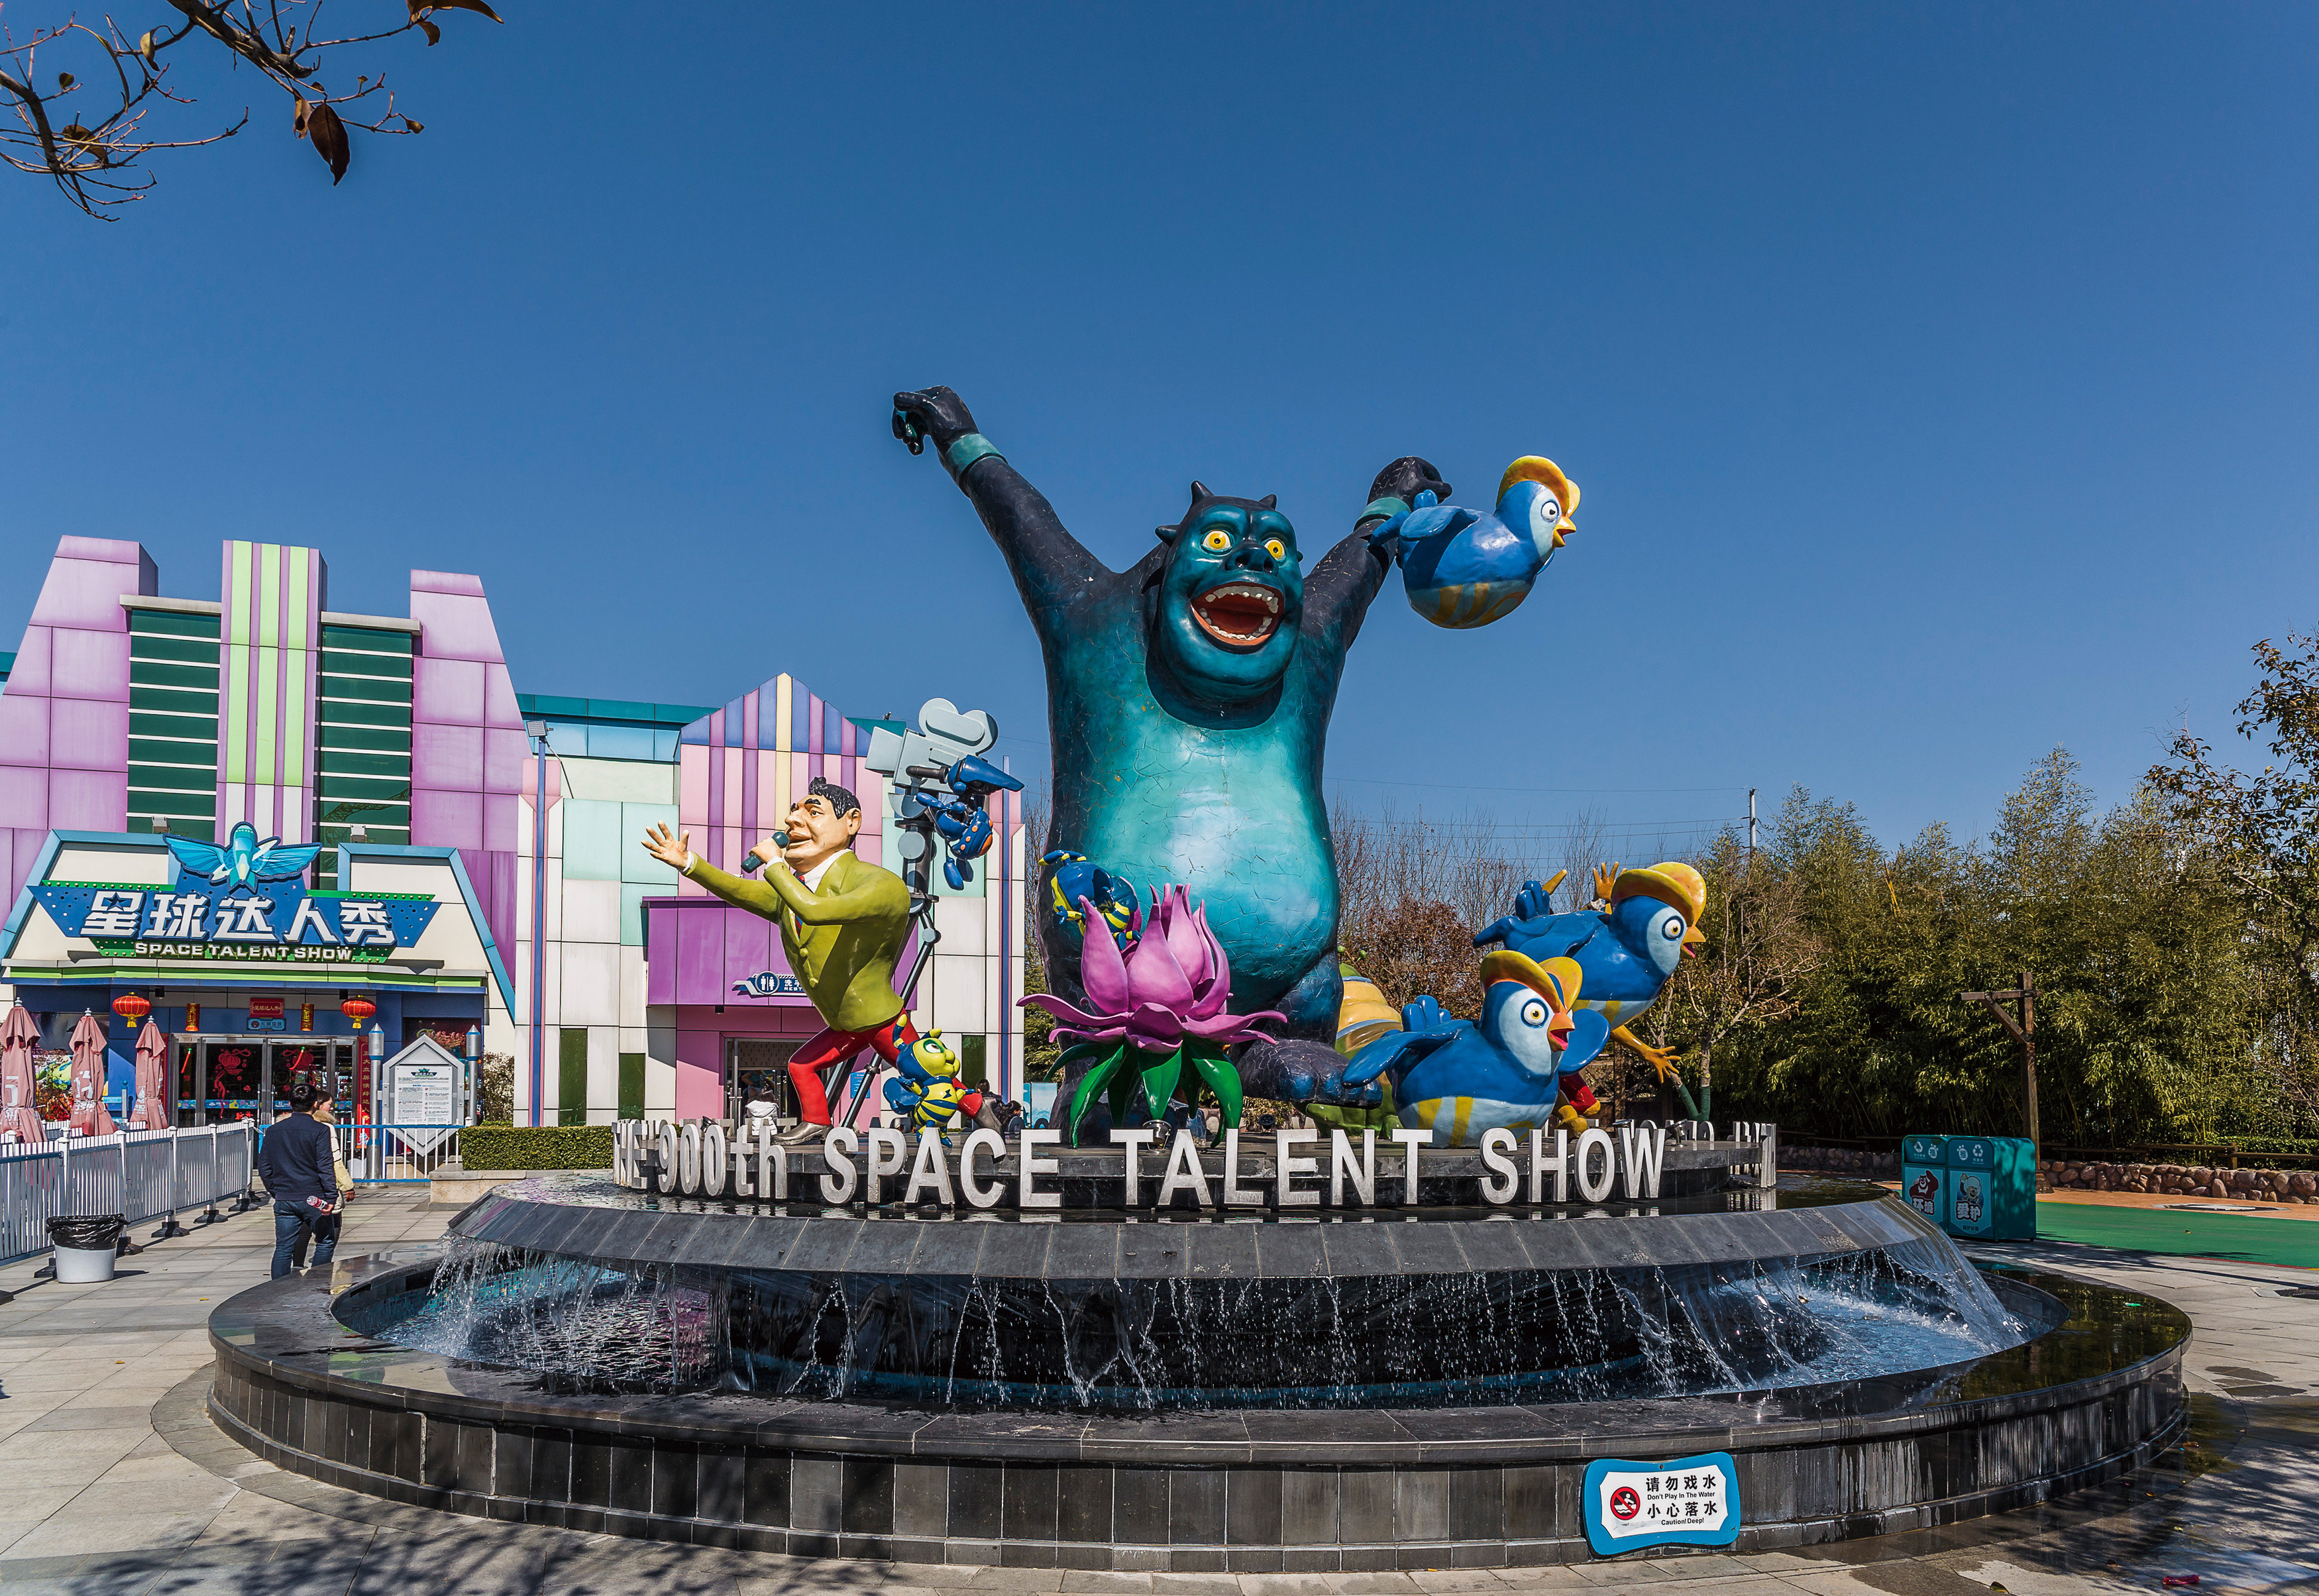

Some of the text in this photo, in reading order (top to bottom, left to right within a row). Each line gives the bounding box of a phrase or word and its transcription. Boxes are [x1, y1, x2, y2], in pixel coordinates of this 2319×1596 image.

[80, 890, 396, 945] 星球达人秀
[135, 942, 353, 961] SPACE TALENT SHOW
[658, 1124, 788, 1199] 900th
[820, 1127, 1063, 1209] SPACE
[1110, 1128, 1433, 1207] TALENT
[1478, 1127, 1666, 1204] SHOW
[1912, 1198, 1934, 1214] 环境
[1957, 1202, 1981, 1222] 爱护
[1646, 1474, 1716, 1492] 请勿戏水
[1647, 1501, 1717, 1518] 小心落水
